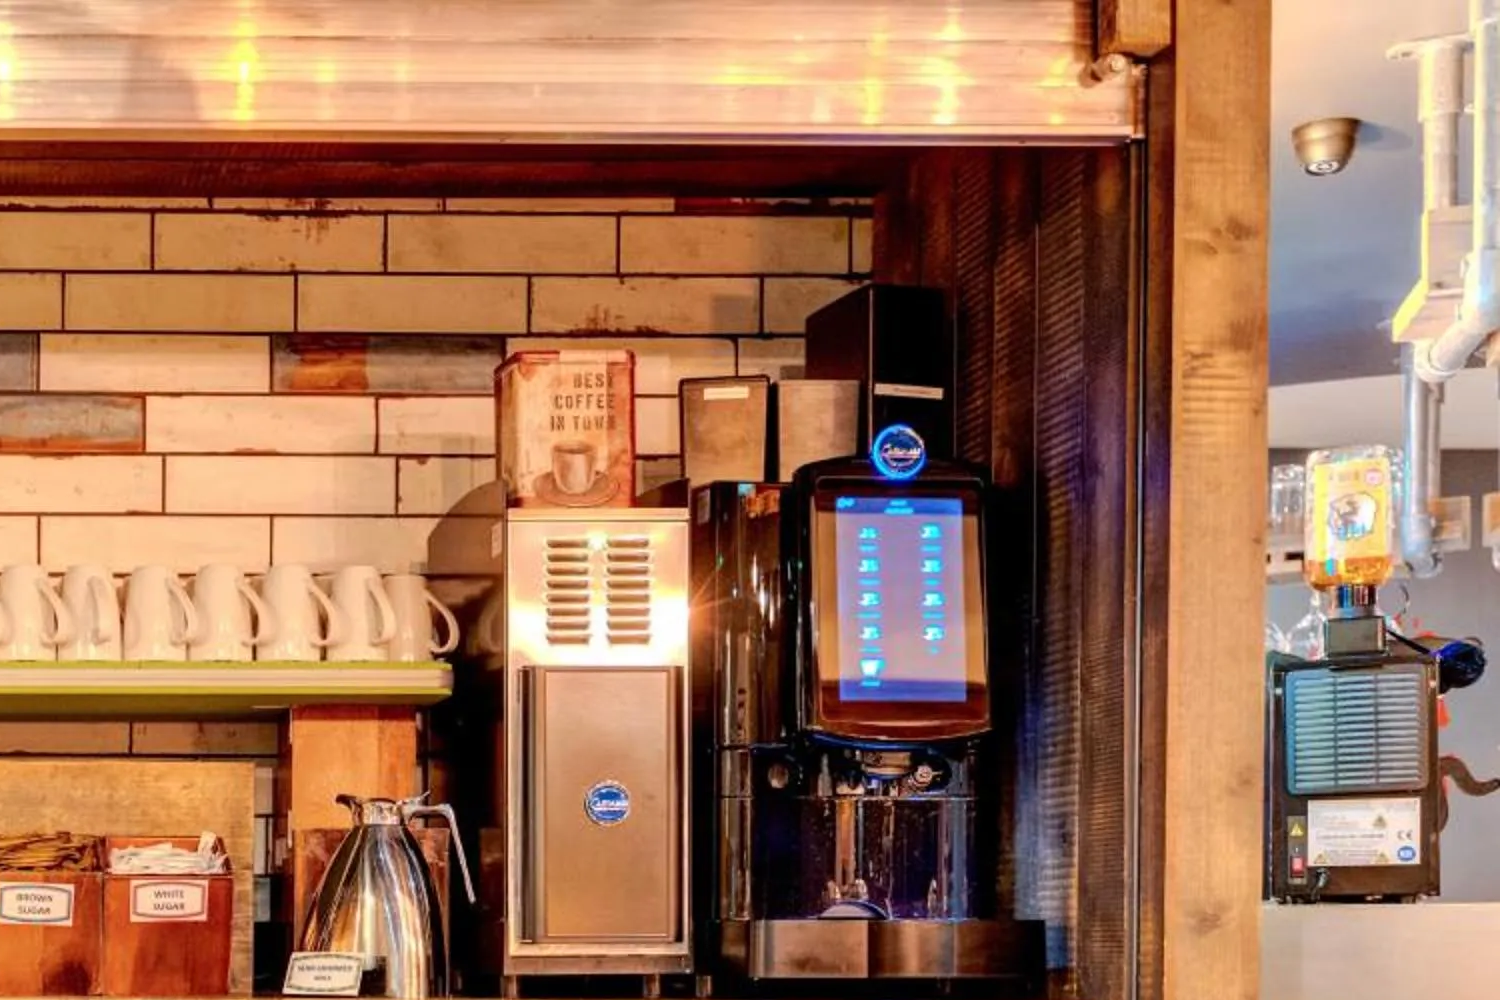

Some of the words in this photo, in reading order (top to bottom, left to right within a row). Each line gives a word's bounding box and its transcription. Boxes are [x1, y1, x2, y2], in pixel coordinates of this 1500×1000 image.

[573, 373, 613, 389] BEST
[554, 394, 616, 409] COFFEE
[550, 415, 565, 431] IN
[573, 415, 616, 431] TOWN
[16, 893, 53, 902] BROWN
[153, 889, 185, 899] WHITE
[17, 905, 51, 915] SUGAR
[153, 903, 185, 911] SUGAR
